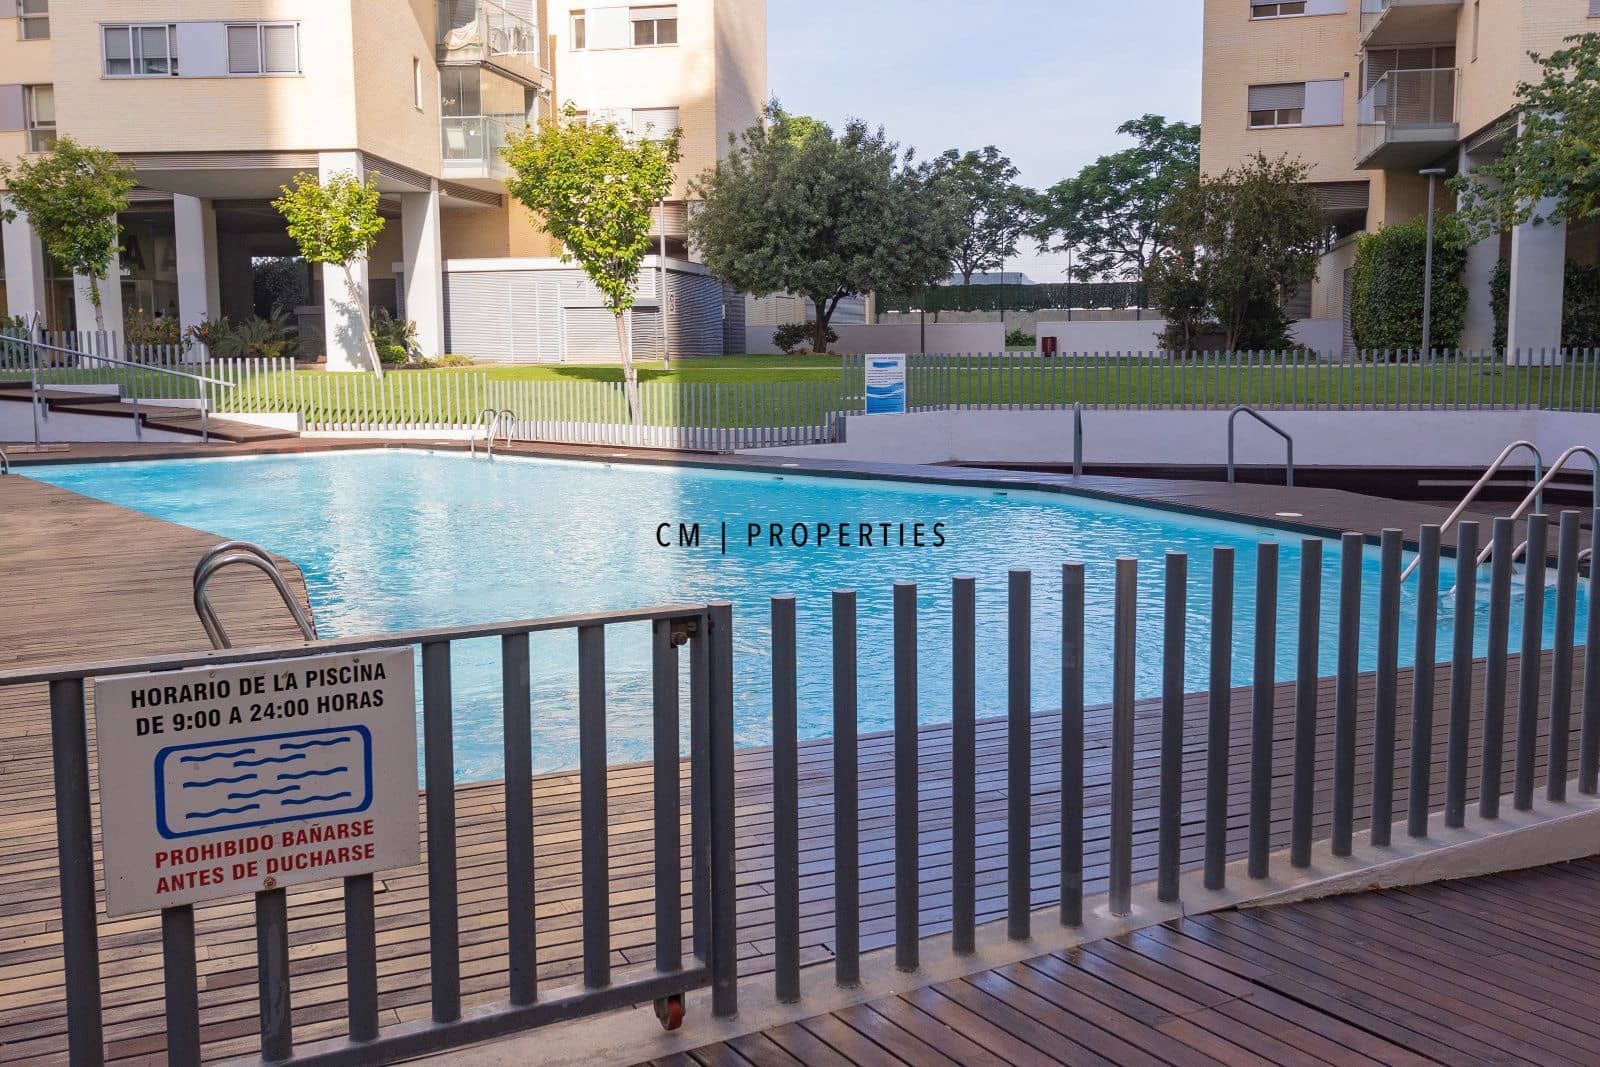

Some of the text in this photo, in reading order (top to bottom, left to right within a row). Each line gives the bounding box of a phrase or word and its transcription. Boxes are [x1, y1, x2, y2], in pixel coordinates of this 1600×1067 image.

[130, 662, 387, 709] HORARIO DE LA PISCINA
[135, 688, 384, 737] DE 9:00 A 24:00 HORAS
[154, 818, 375, 870] PROHIBIDO BAÑARSE
[155, 842, 377, 895] ANTES DE DUCHARSE
